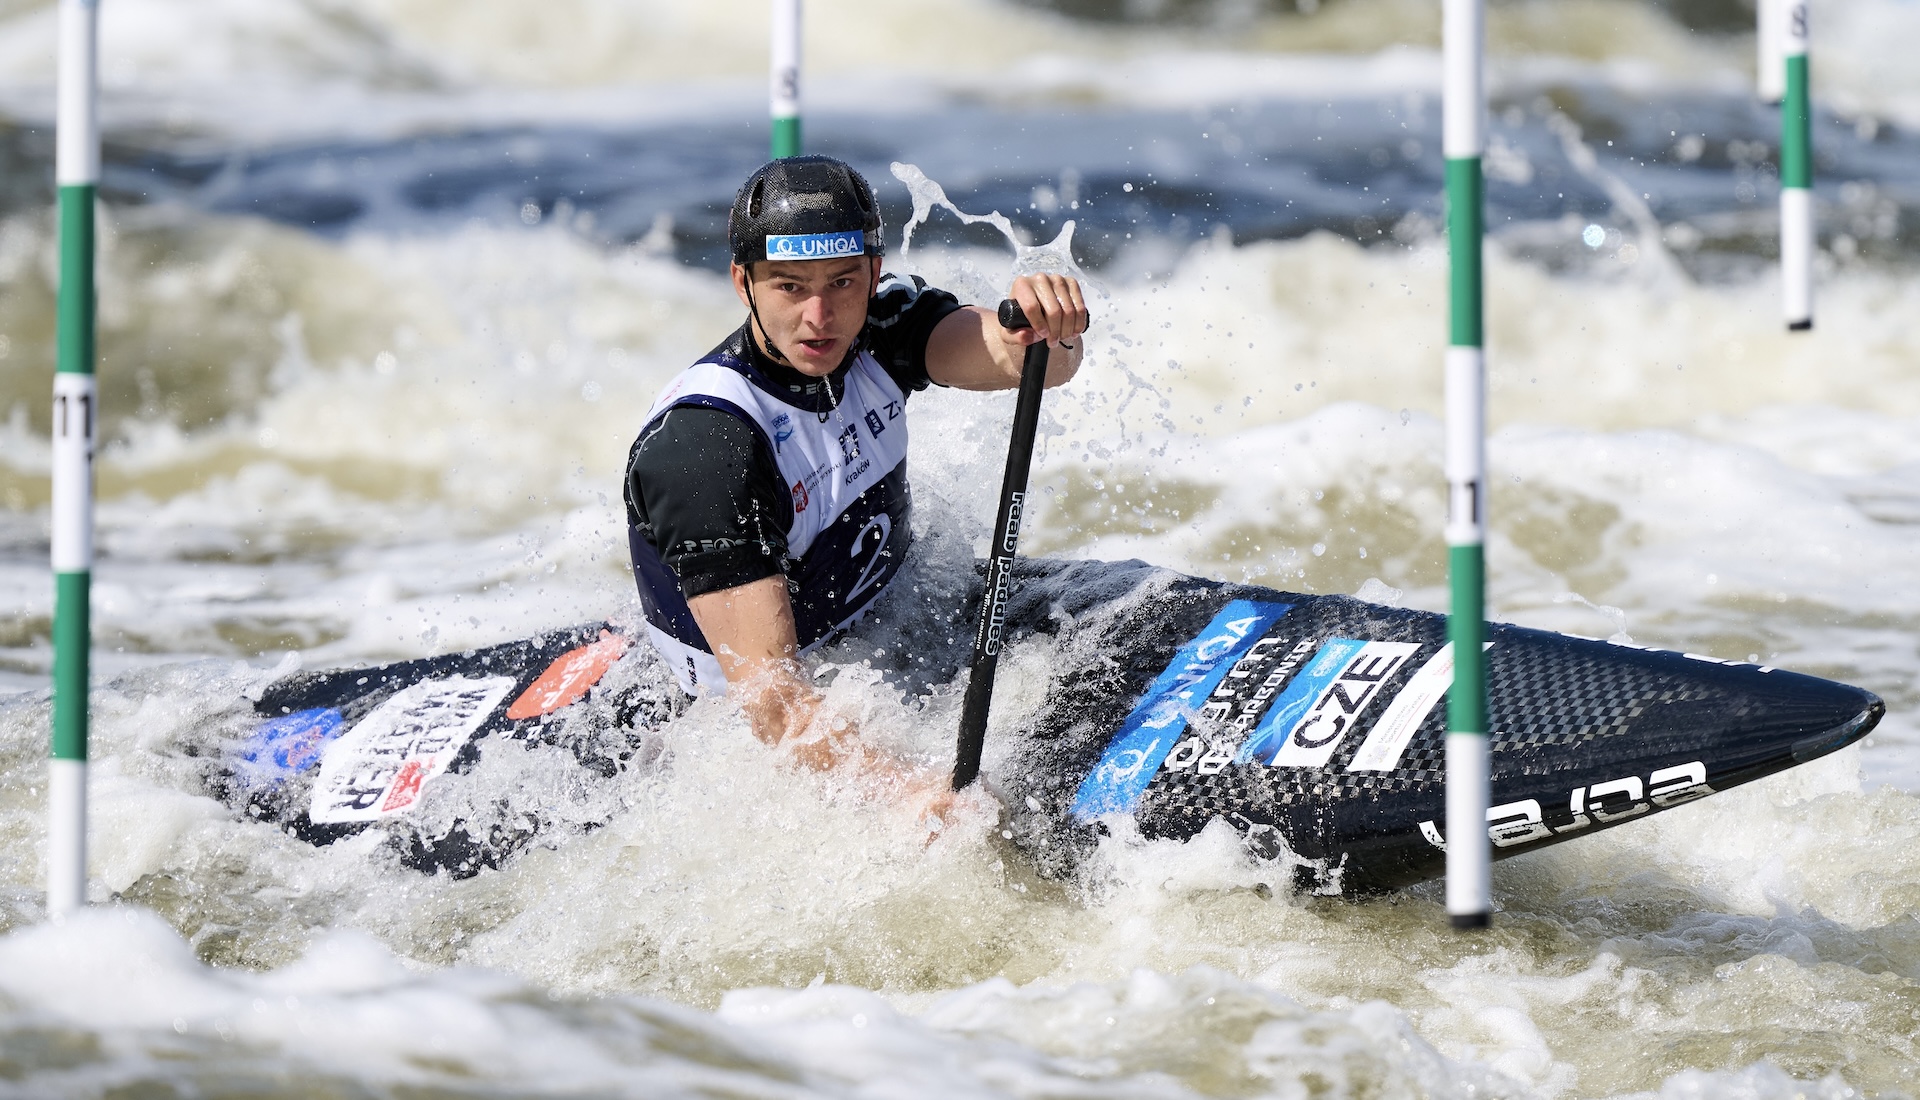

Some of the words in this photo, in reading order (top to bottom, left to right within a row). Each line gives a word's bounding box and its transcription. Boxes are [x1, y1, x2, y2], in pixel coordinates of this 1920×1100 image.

[801, 236, 859, 255] UNIQA
[845, 458, 871, 487] Kraków
[845, 512, 892, 605] 2
[1003, 491, 1026, 553] raab
[985, 556, 1013, 656] paddles
[1294, 652, 1404, 750] CZE
